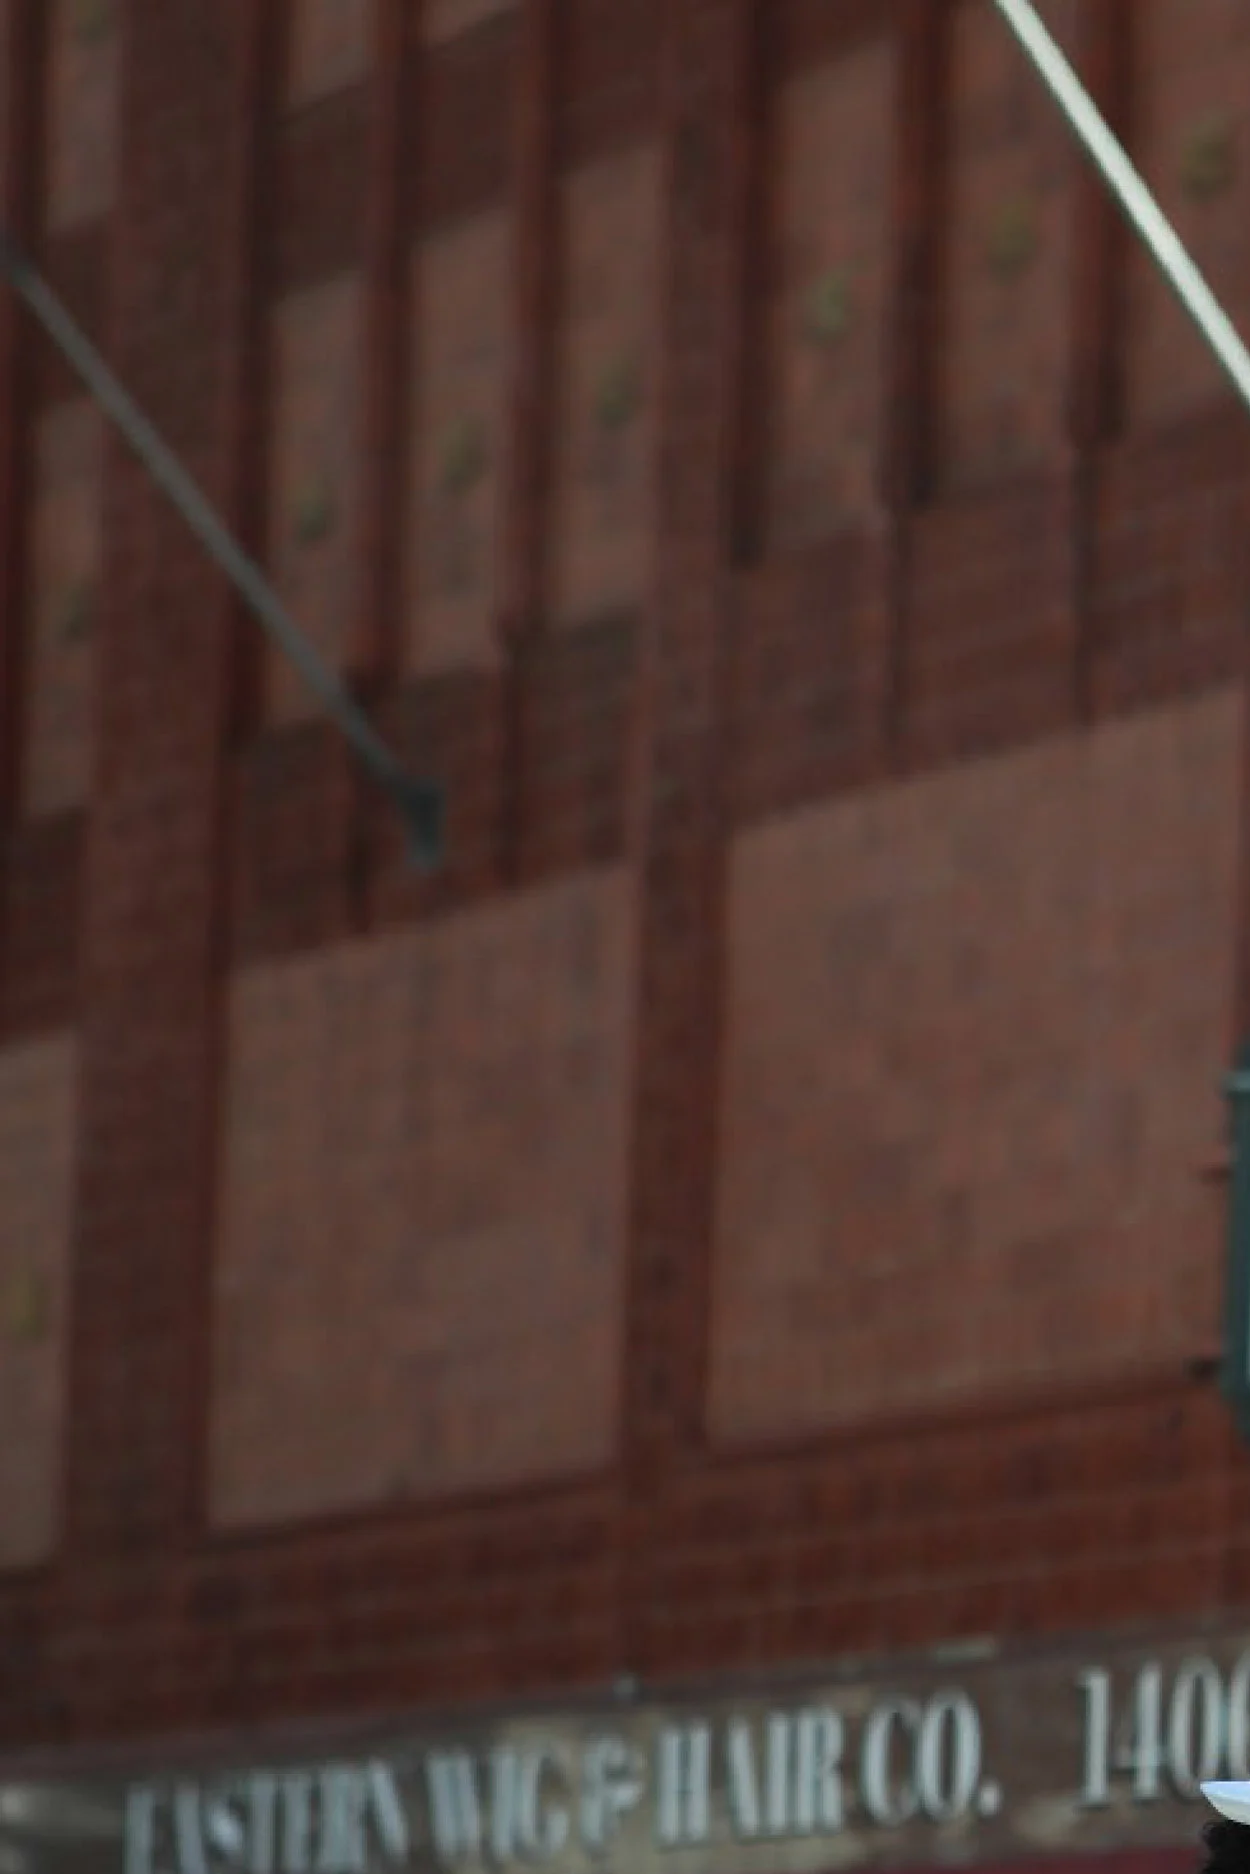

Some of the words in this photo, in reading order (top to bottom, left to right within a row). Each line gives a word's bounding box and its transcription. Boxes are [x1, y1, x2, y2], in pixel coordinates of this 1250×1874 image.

[427, 1738, 570, 1865] WIG
[657, 1705, 843, 1850] HAIR
[861, 1686, 1001, 1822] CO.
